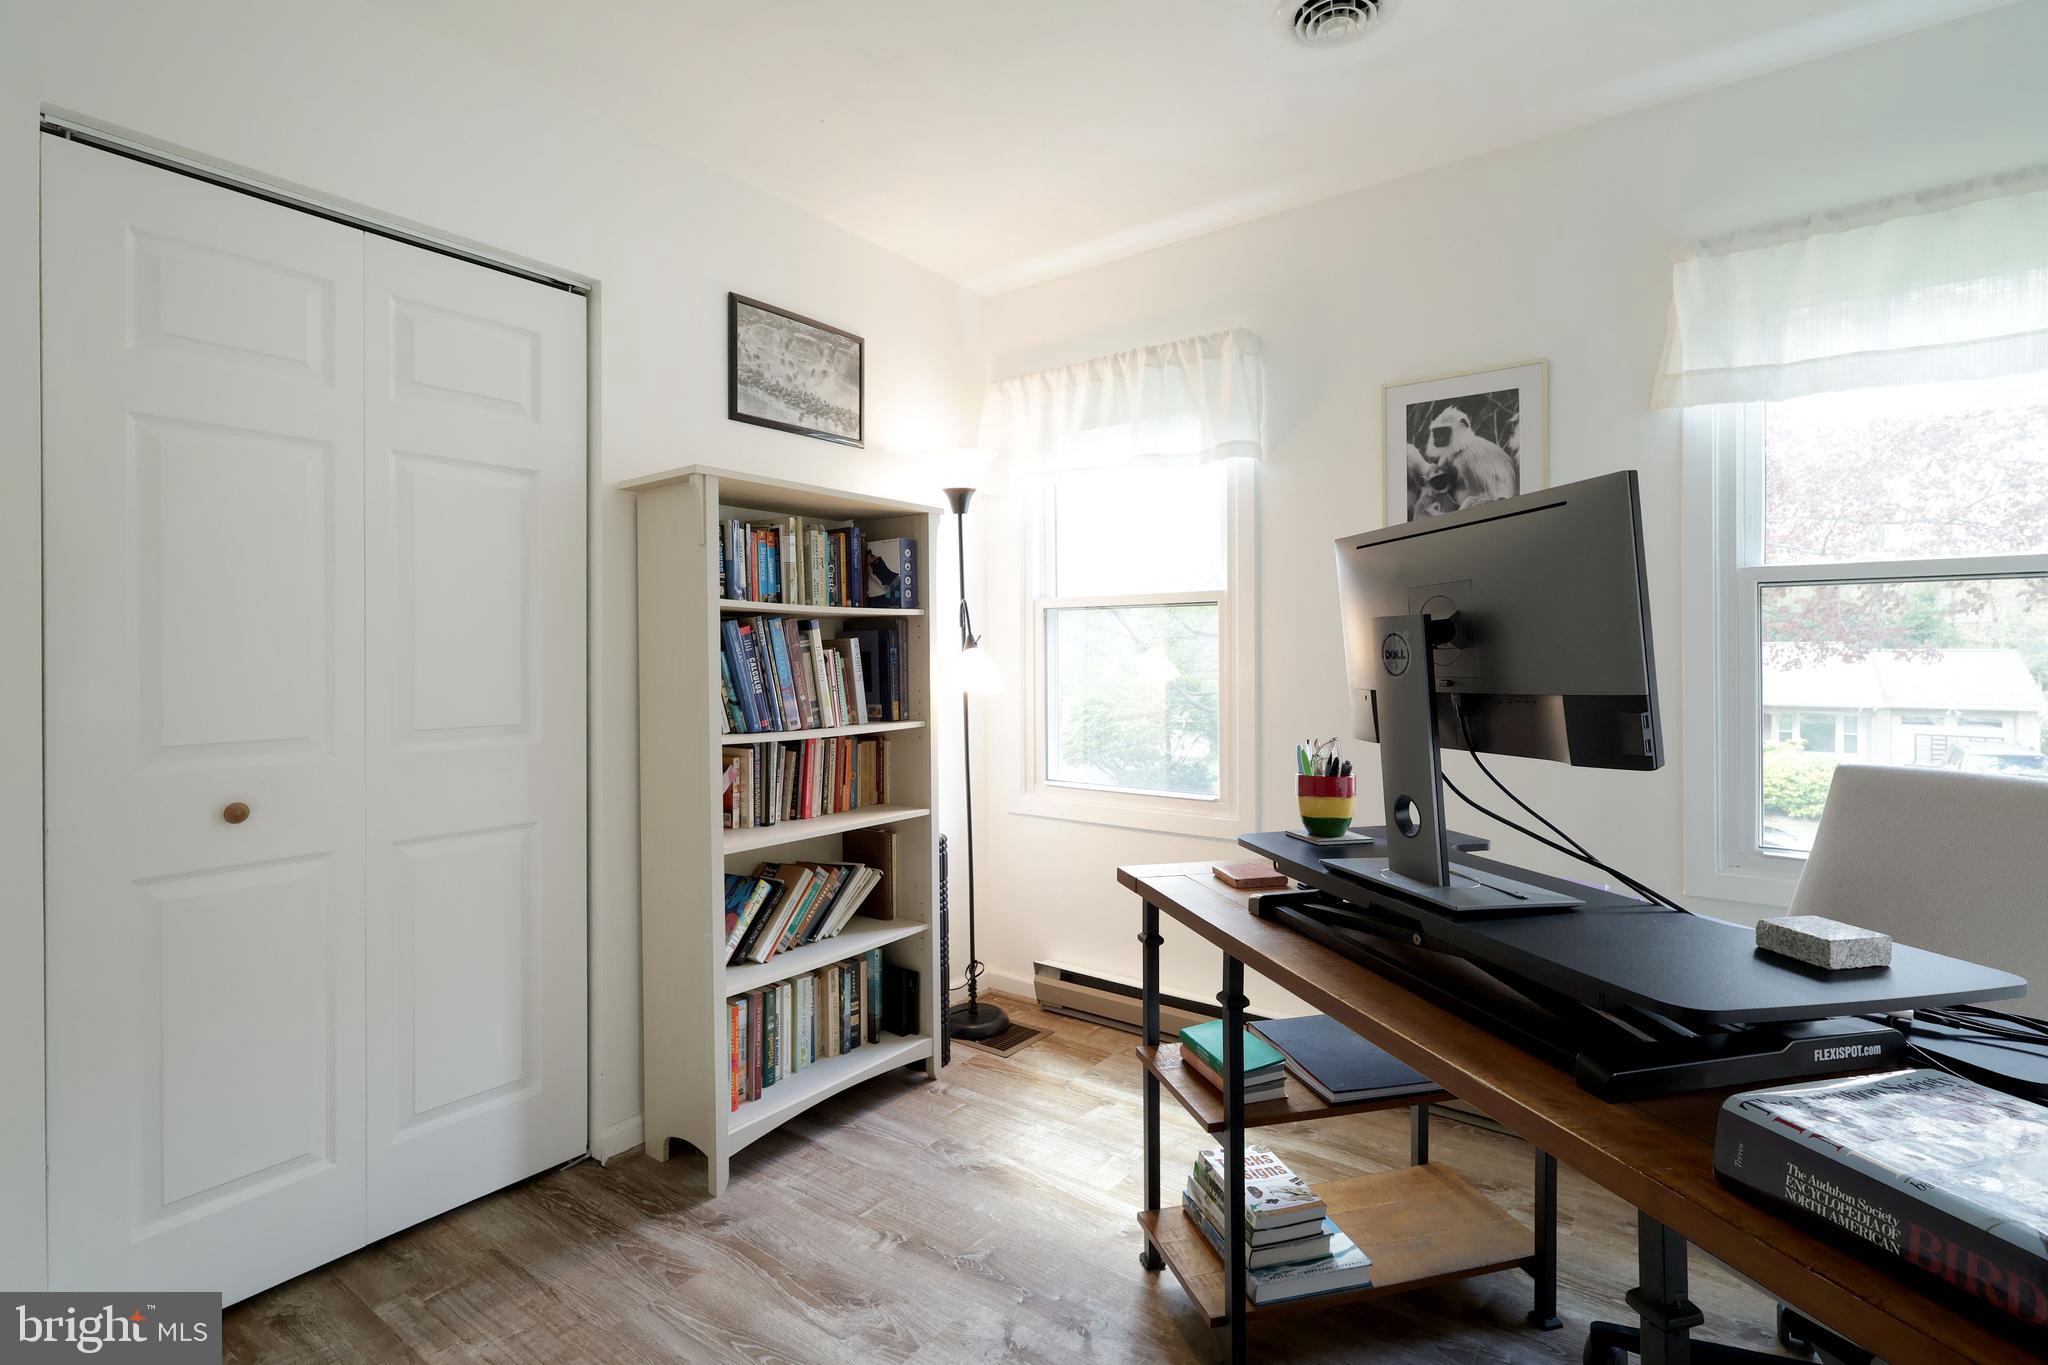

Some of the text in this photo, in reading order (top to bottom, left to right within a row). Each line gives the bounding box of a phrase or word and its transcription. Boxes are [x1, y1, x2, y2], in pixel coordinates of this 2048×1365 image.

[759, 547, 767, 582] Morocco
[828, 564, 836, 593] Caste
[1385, 649, 1407, 660] DELL
[749, 657, 763, 695] CALCULUS
[767, 1032, 775, 1069] Wetlands
[1814, 1045, 1881, 1062] FLEXISPOT.com
[1785, 1175, 1901, 1241] ENCYCLOPEDIA OF
[1786, 1162, 1900, 1228] The Audubon Society
[1785, 1187, 1900, 1256] NORTH AMERICAN
